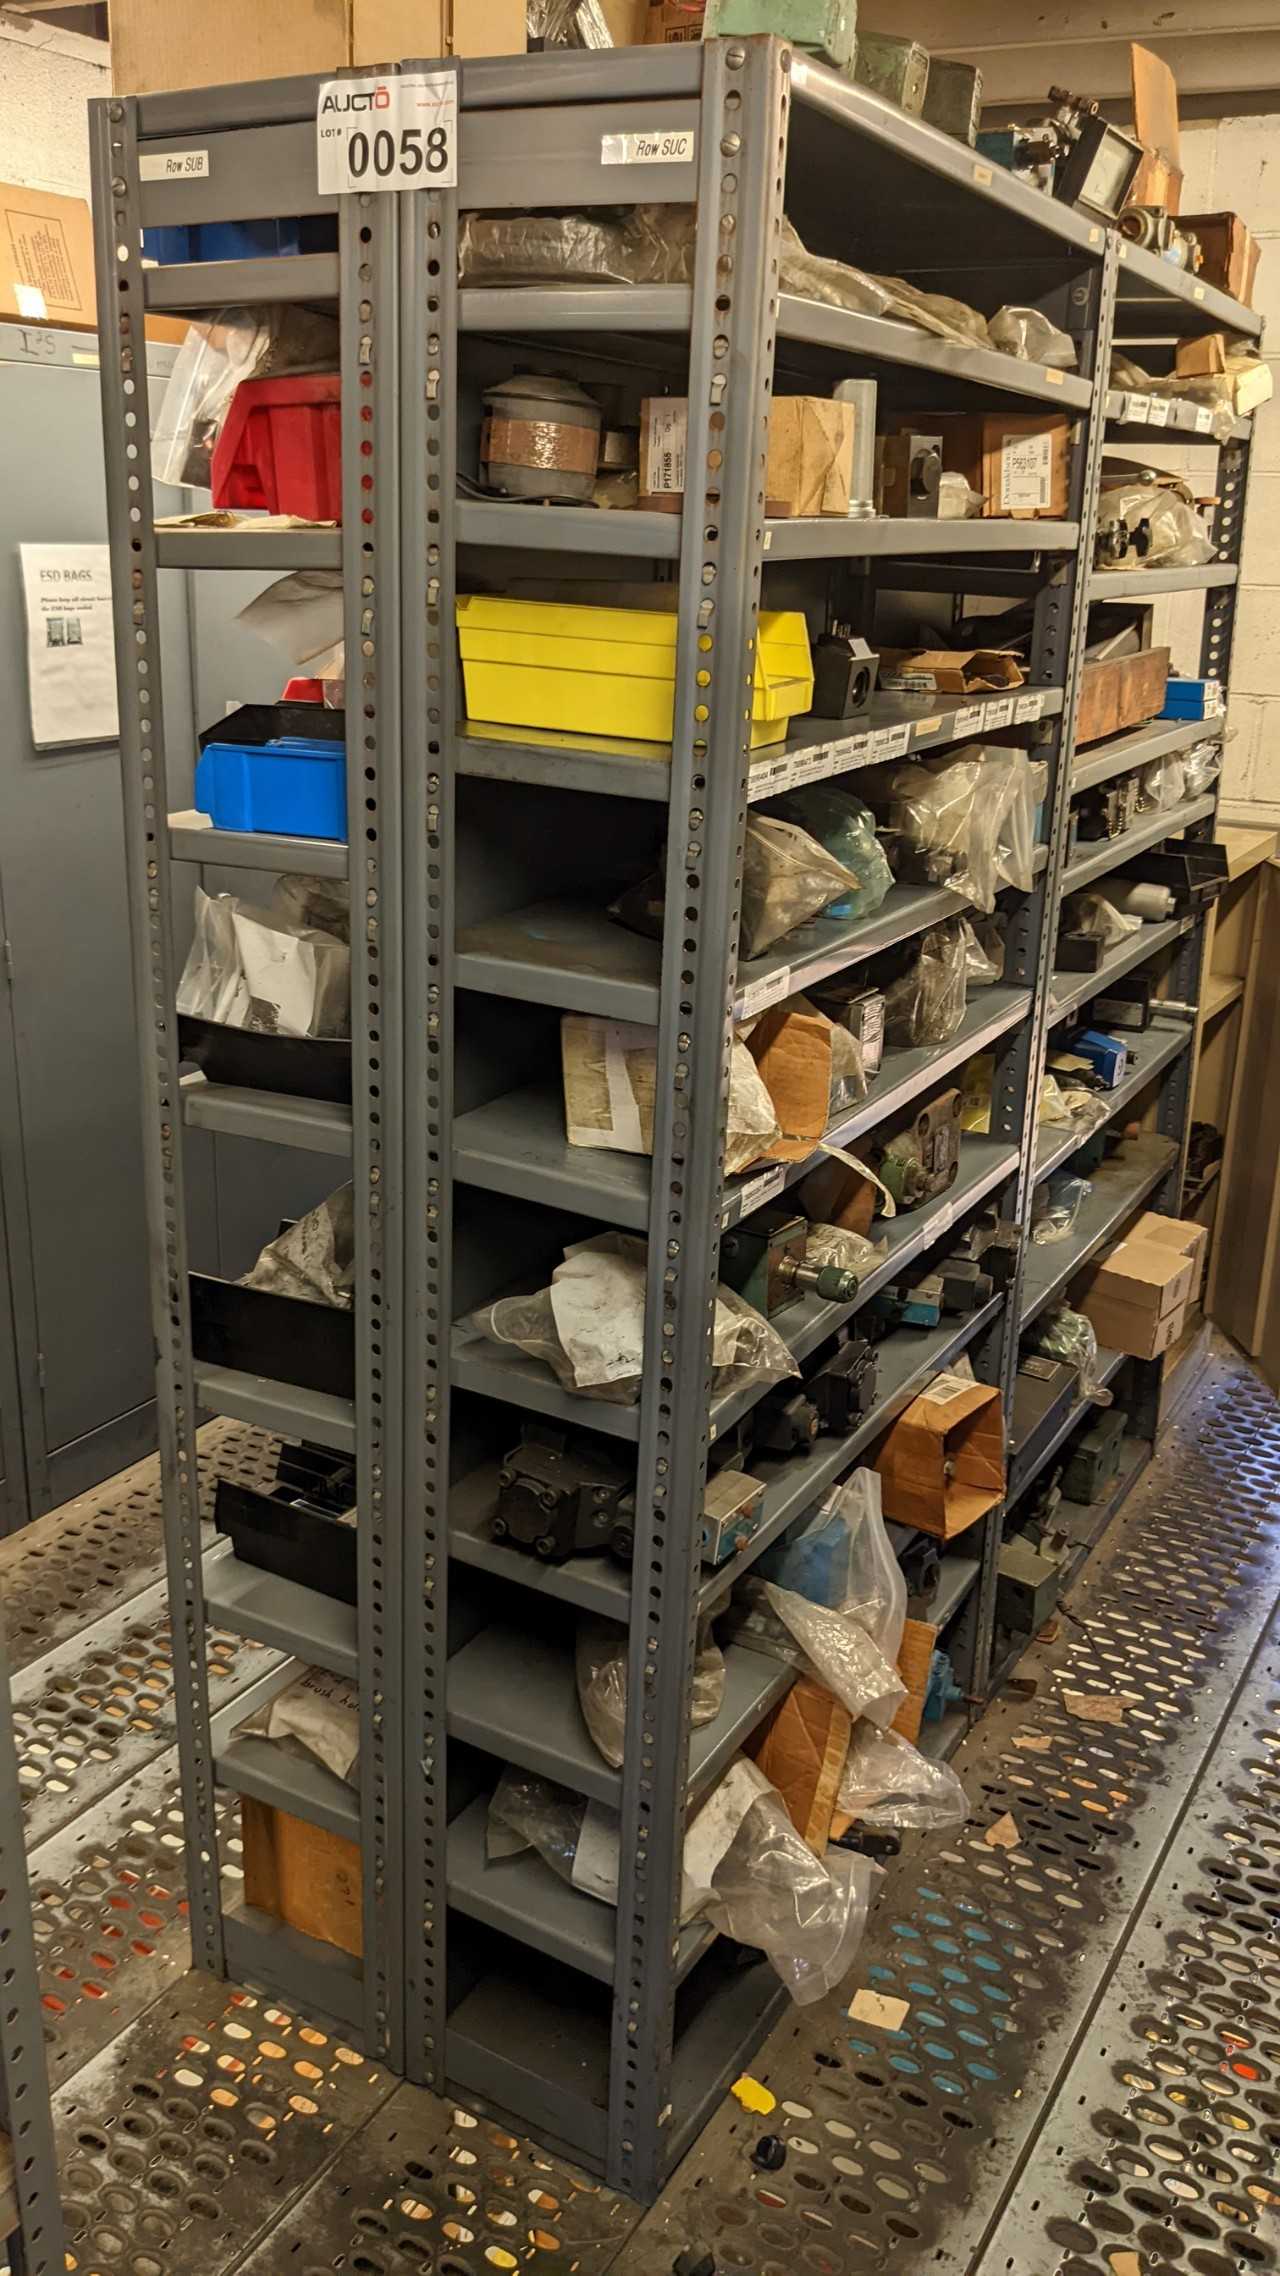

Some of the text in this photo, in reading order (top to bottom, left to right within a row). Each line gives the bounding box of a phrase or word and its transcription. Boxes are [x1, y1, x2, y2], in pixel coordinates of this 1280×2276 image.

[320, 129, 336, 138] LOT
[348, 127, 448, 178] 0058
[636, 138, 687, 156] Row SUC
[166, 157, 204, 173] Row SUB
[40, 569, 93, 582] ESD BAGS
